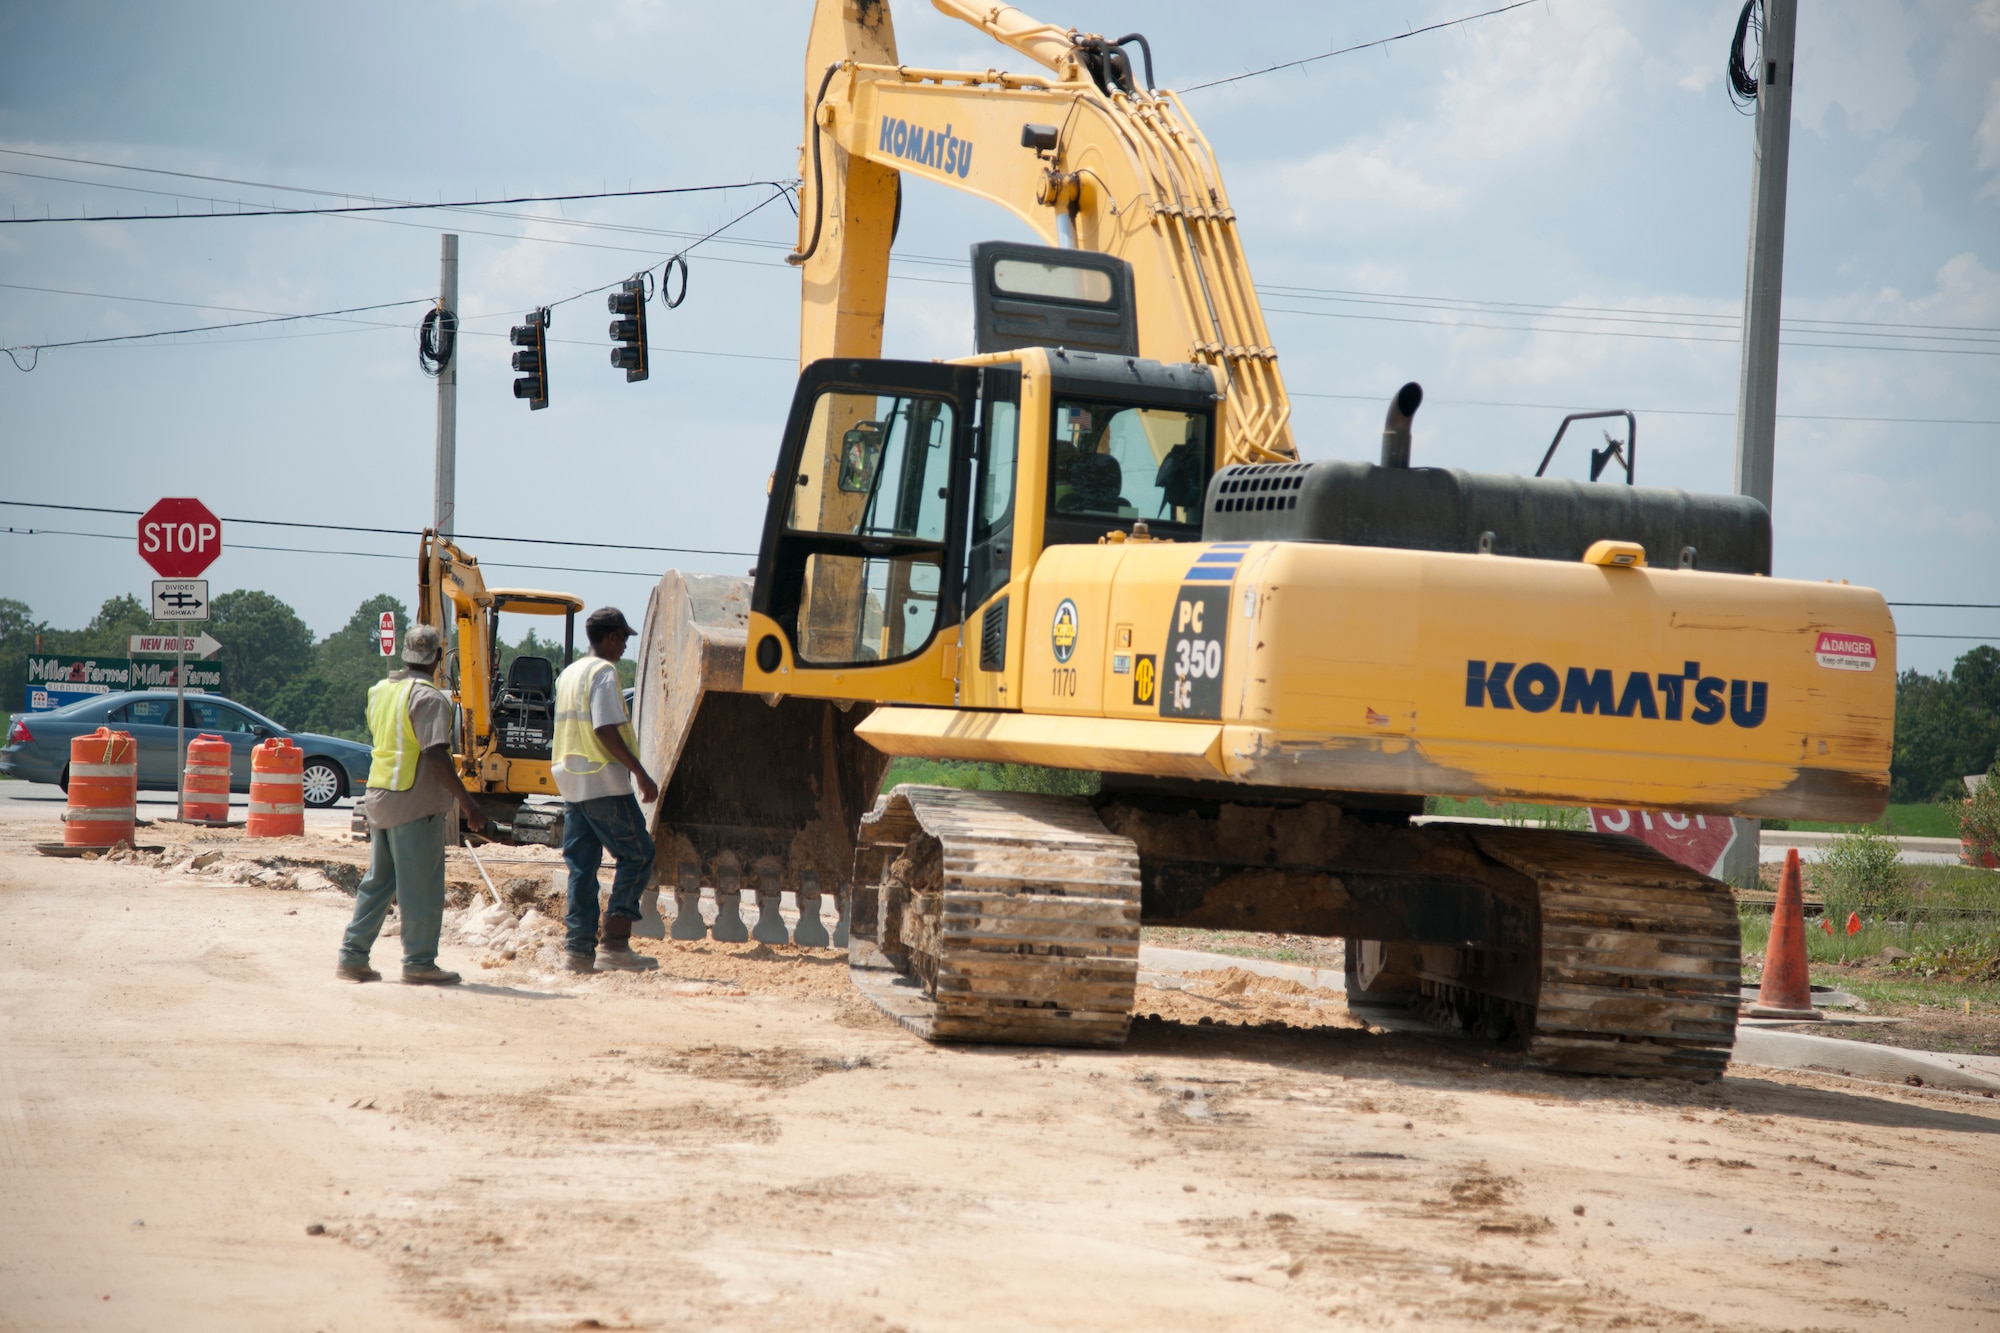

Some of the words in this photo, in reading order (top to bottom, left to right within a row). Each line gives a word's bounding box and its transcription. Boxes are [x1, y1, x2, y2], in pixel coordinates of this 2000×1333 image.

[879, 115, 974, 179] KOMATSU
[143, 522, 217, 553] STOP
[1178, 600, 1204, 634] PC
[140, 638, 161, 650] NEW
[164, 638, 195, 651] HOES
[1174, 638, 1222, 679] 350
[1831, 640, 1872, 655] DANGER
[28, 658, 73, 682] Miller
[82, 661, 129, 683] Farms
[131, 663, 175, 687] Miller
[182, 664, 220, 686] Farms
[1052, 667, 1077, 697] 1170
[47, 683, 108, 693] SUBDIVISION
[1465, 659, 1769, 728] KOMATSU
